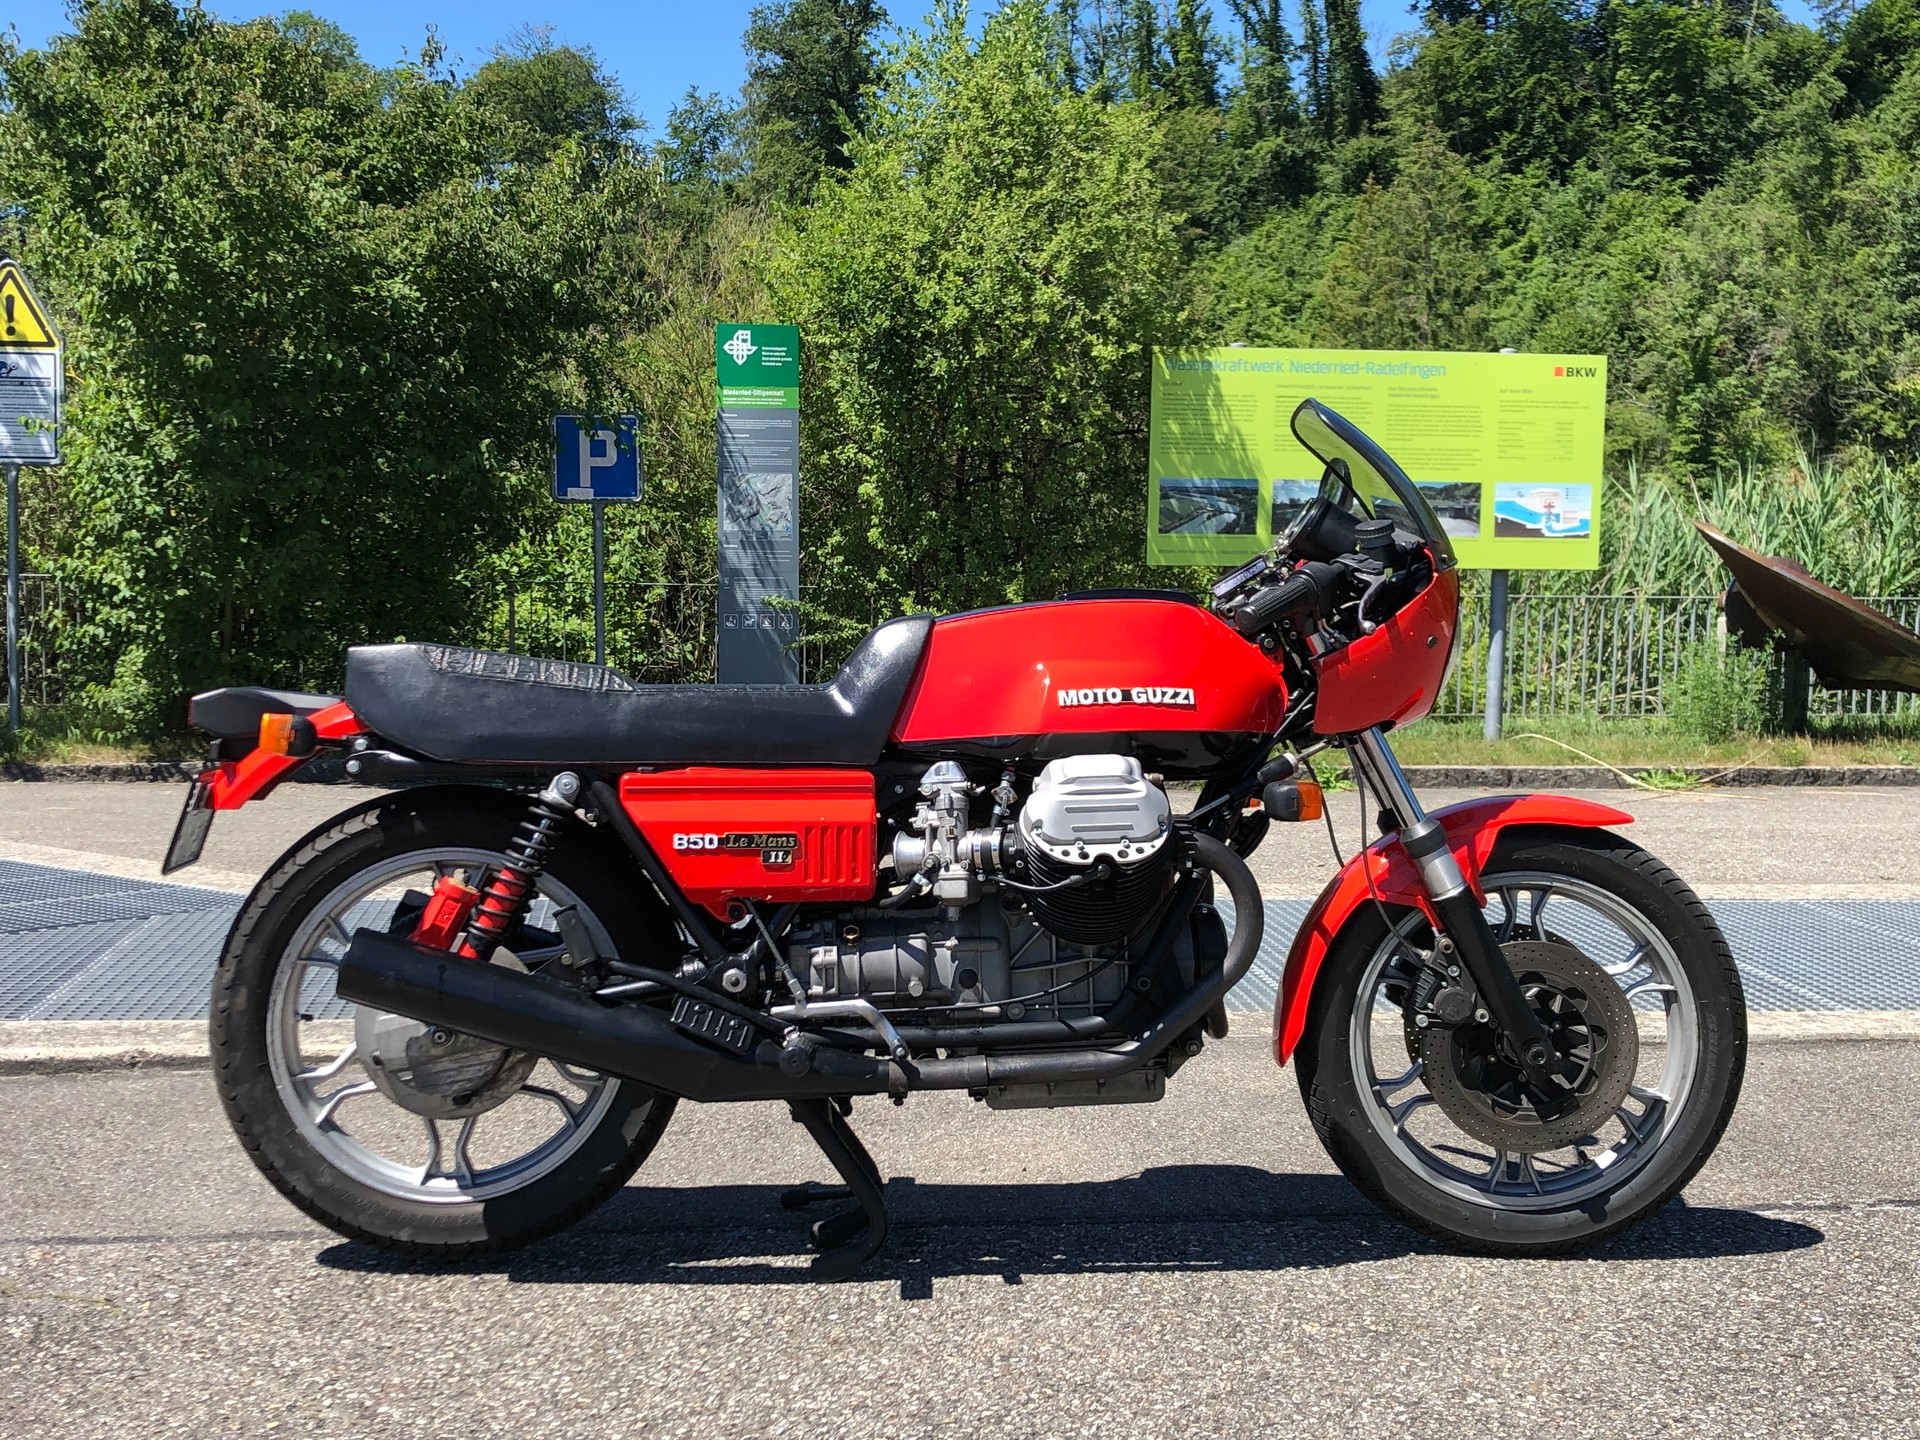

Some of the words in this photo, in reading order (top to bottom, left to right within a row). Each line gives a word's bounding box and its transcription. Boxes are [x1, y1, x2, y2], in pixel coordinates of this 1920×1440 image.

[1289, 359, 1447, 379] Niederried-Radelfingen
[1566, 366, 1597, 377] BKW
[579, 430, 617, 487] P
[1057, 688, 1122, 706] MOTO
[1131, 687, 1195, 705] GUZZI
[673, 833, 718, 849] 850
[727, 835, 748, 847] Le
[751, 835, 796, 848] Mans
